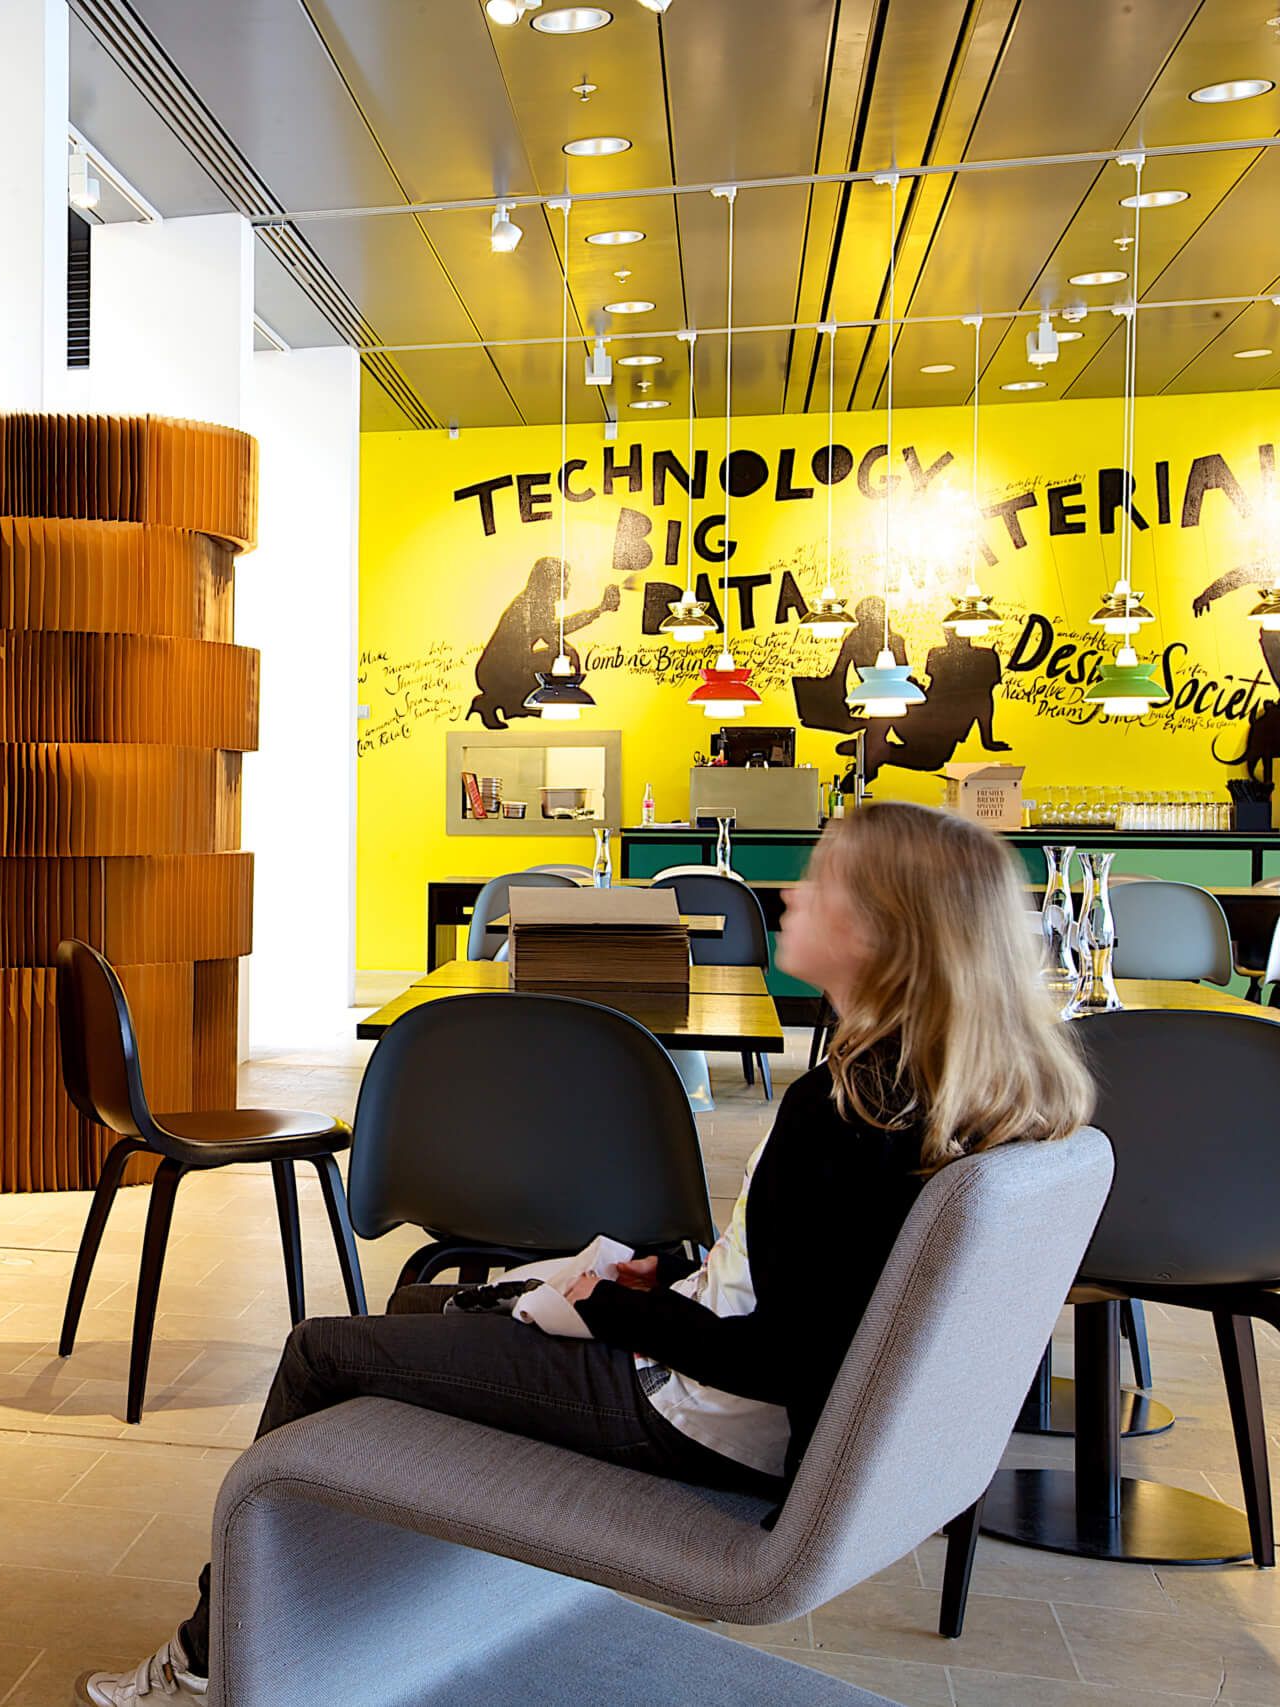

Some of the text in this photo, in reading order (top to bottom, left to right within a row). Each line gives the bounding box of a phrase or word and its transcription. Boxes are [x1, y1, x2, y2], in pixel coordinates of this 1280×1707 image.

[454, 443, 954, 536] TECHNOLOGY
[612, 507, 737, 571] BIG
[642, 570, 809, 635] DATA
[1007, 613, 1104, 724] Desi
[976, 809, 1003, 817] COFFEE
